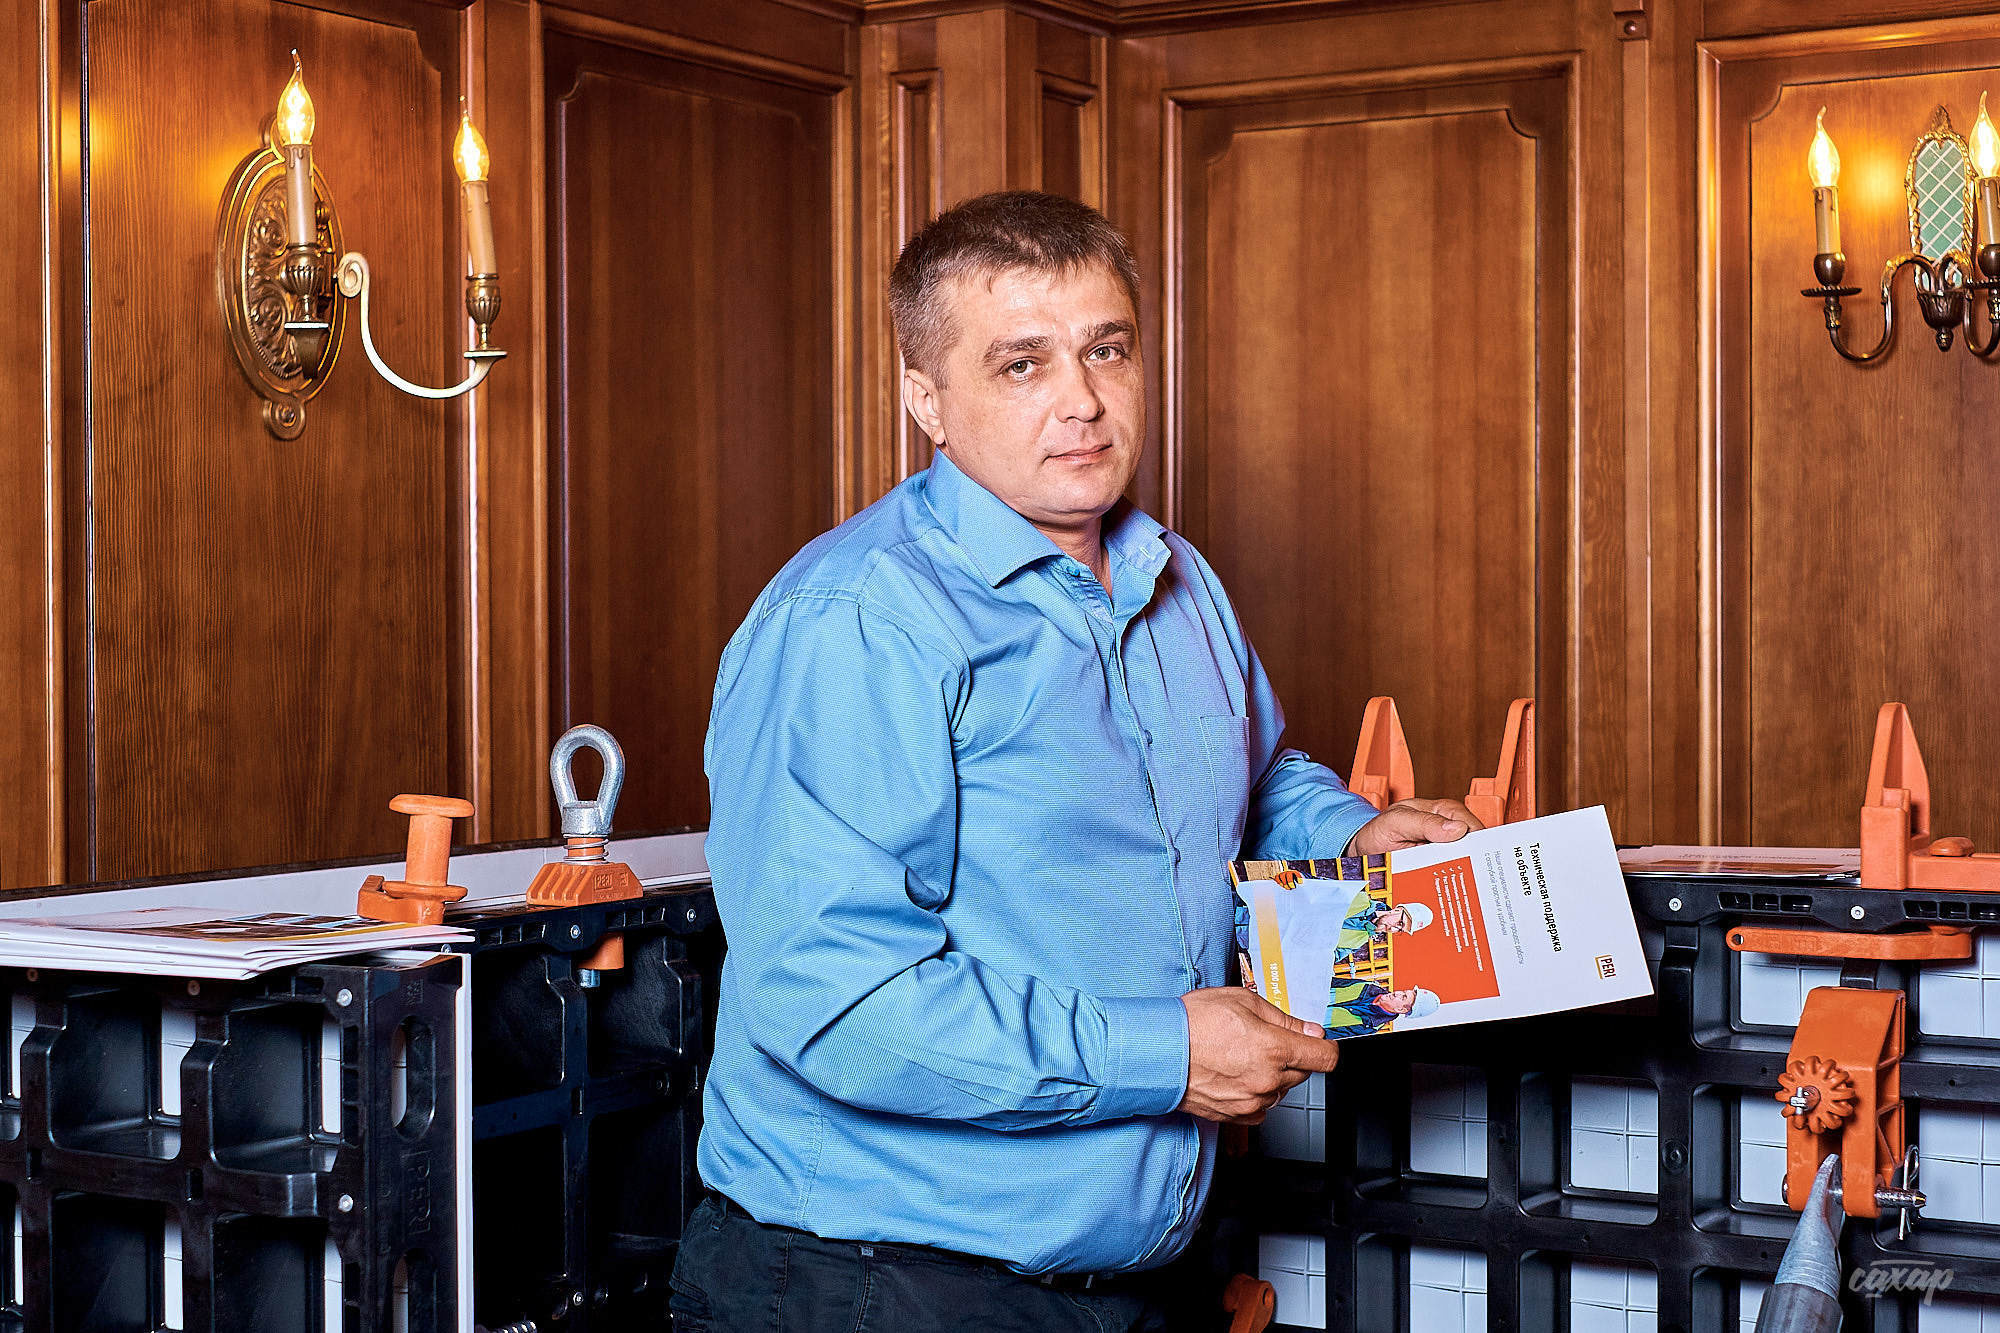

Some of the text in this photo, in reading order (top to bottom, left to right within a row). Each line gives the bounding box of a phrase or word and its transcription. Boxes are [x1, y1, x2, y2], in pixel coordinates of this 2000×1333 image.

[1514, 847, 1532, 896] на объекте
[1530, 843, 1562, 952] Техническая поддержка
[1600, 958, 1616, 977] PERI
